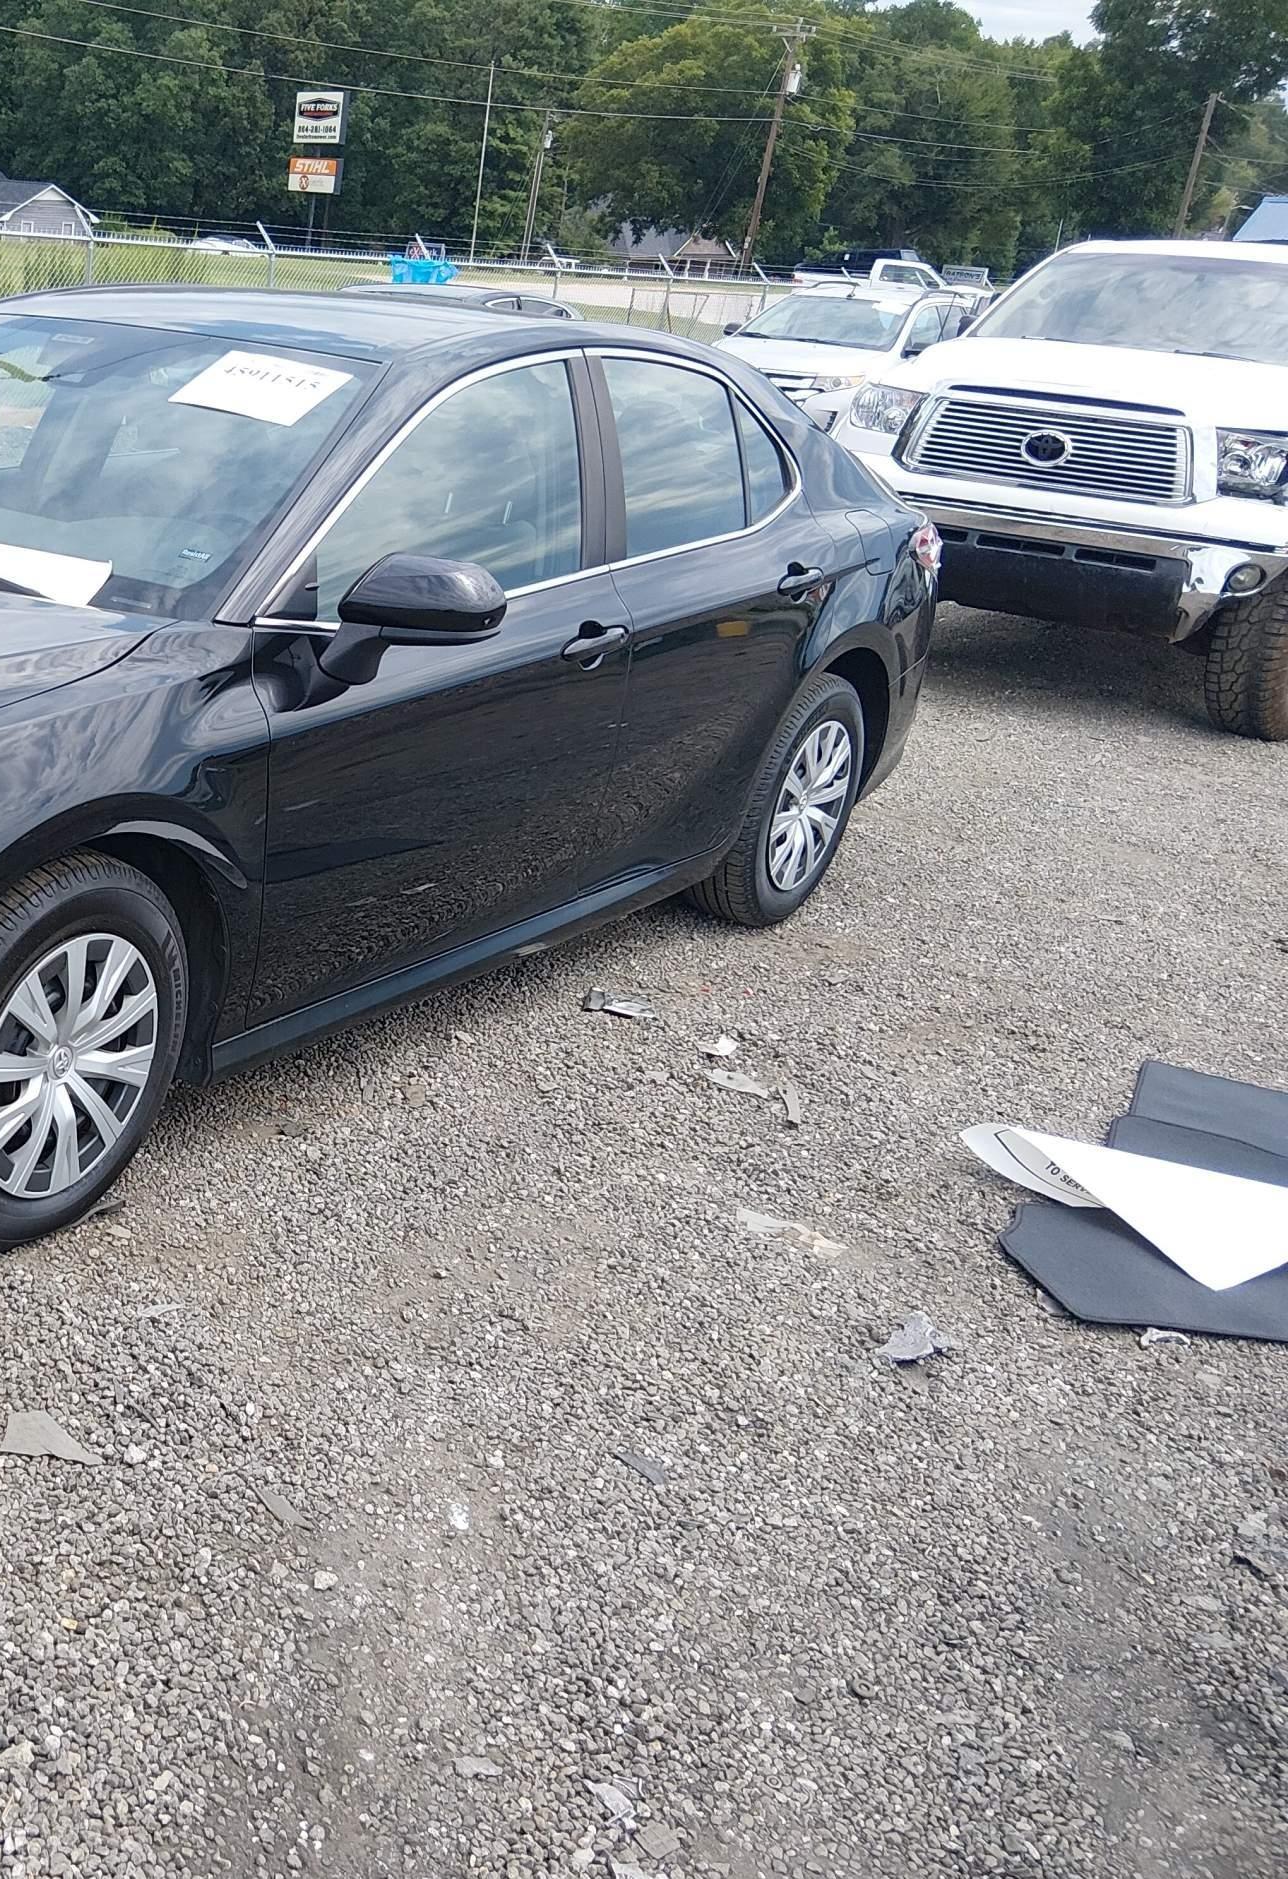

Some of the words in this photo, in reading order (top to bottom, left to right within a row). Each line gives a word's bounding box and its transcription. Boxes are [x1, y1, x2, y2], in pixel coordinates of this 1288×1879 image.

[300, 103, 315, 112] FIVE
[316, 103, 338, 112] FORKS
[294, 161, 330, 174] STIHL
[1045, 1160, 1061, 1176] TO
